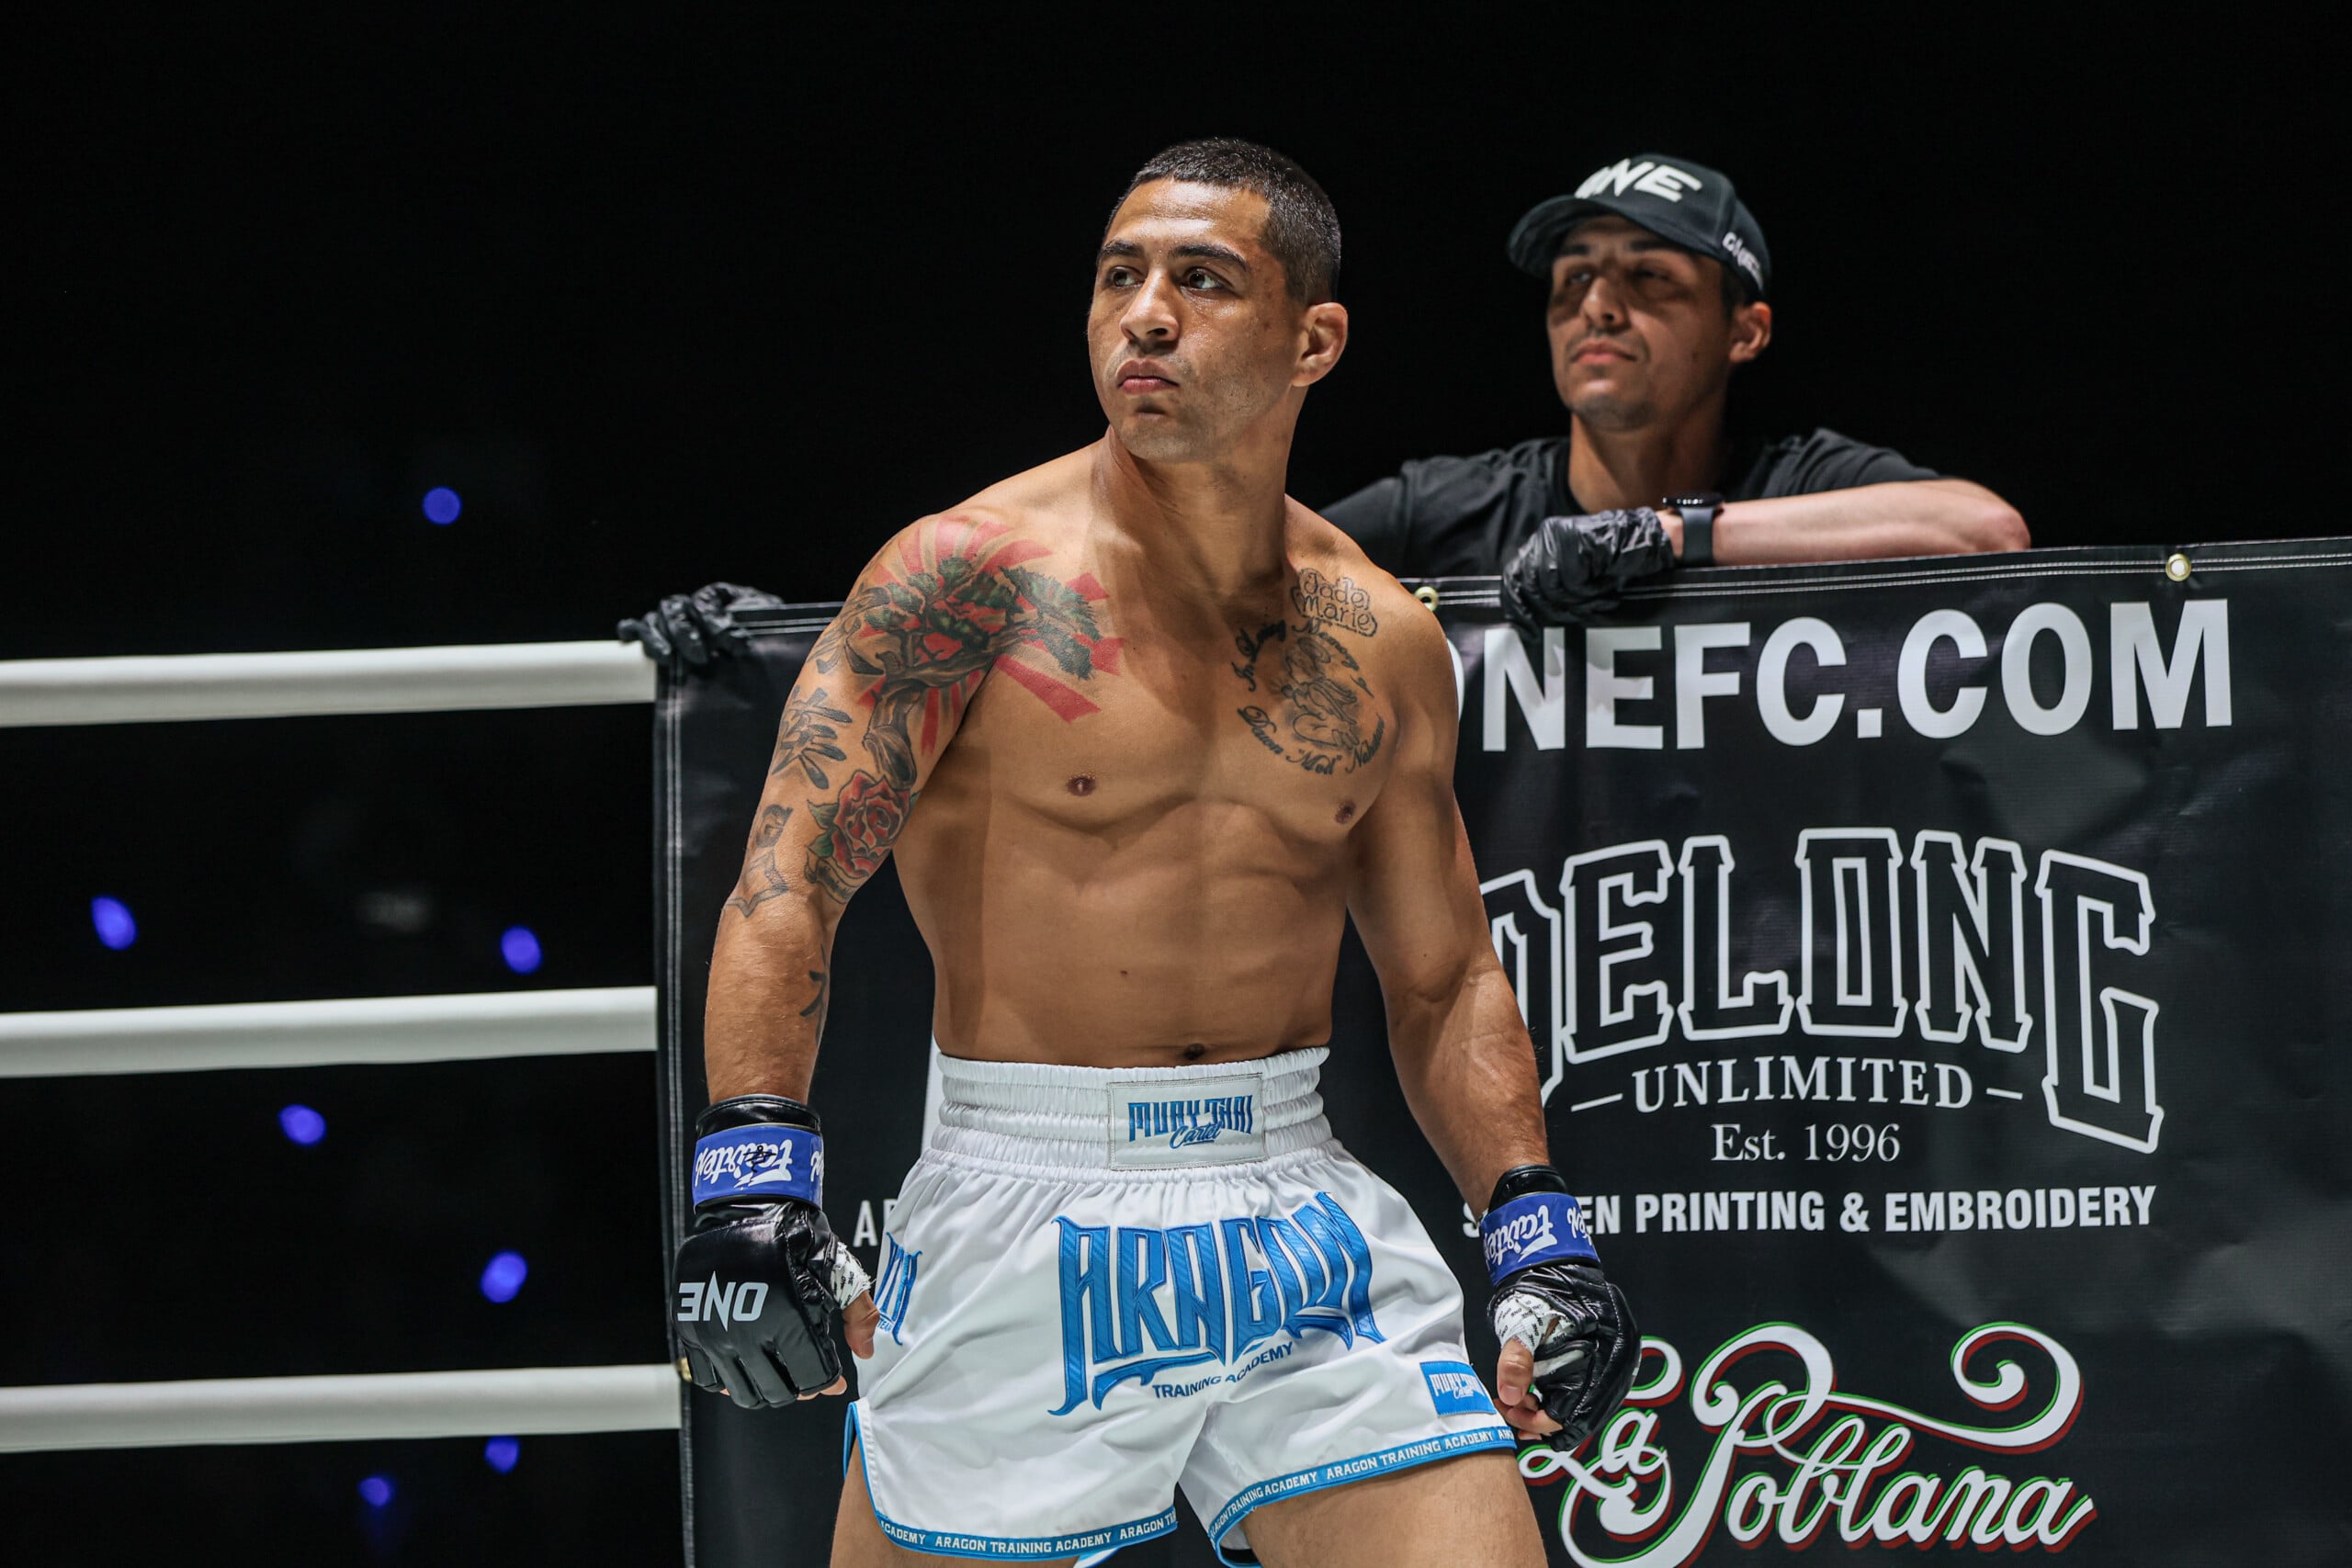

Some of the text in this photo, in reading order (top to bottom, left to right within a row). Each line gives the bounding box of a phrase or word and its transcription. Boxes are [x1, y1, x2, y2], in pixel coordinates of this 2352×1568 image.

[1451, 599, 2233, 751] NEFC.COM
[1632, 1055, 1973, 1113] UNLIMITED
[1128, 1100, 1201, 1142] MUAY
[1170, 1121, 1223, 1149] Cartel
[1712, 1123, 1900, 1161] Est. 1996
[695, 1139, 793, 1189] Fairtex
[1635, 1190, 1825, 1234] PRINTING
[1839, 1191, 1870, 1233] &
[1885, 1186, 2156, 1232] EMBROIDERY
[677, 1270, 769, 1331] ONE
[1152, 1341, 1294, 1399] TRAINING ACADEMY
[1519, 1321, 2098, 1568] La Poblana
[1227, 1486, 1264, 1517] TRAINING
[1264, 1472, 1317, 1495] ACADEMY
[1327, 1457, 1378, 1481] ARAGON
[1379, 1440, 1442, 1466] TRAINING
[1444, 1430, 1494, 1450] ACADEMY
[935, 1536, 987, 1551] ARAGON
[990, 1540, 1052, 1553] TRAINING
[1056, 1532, 1112, 1551] ACADEMY
[1120, 1517, 1164, 1540] ARAGON
